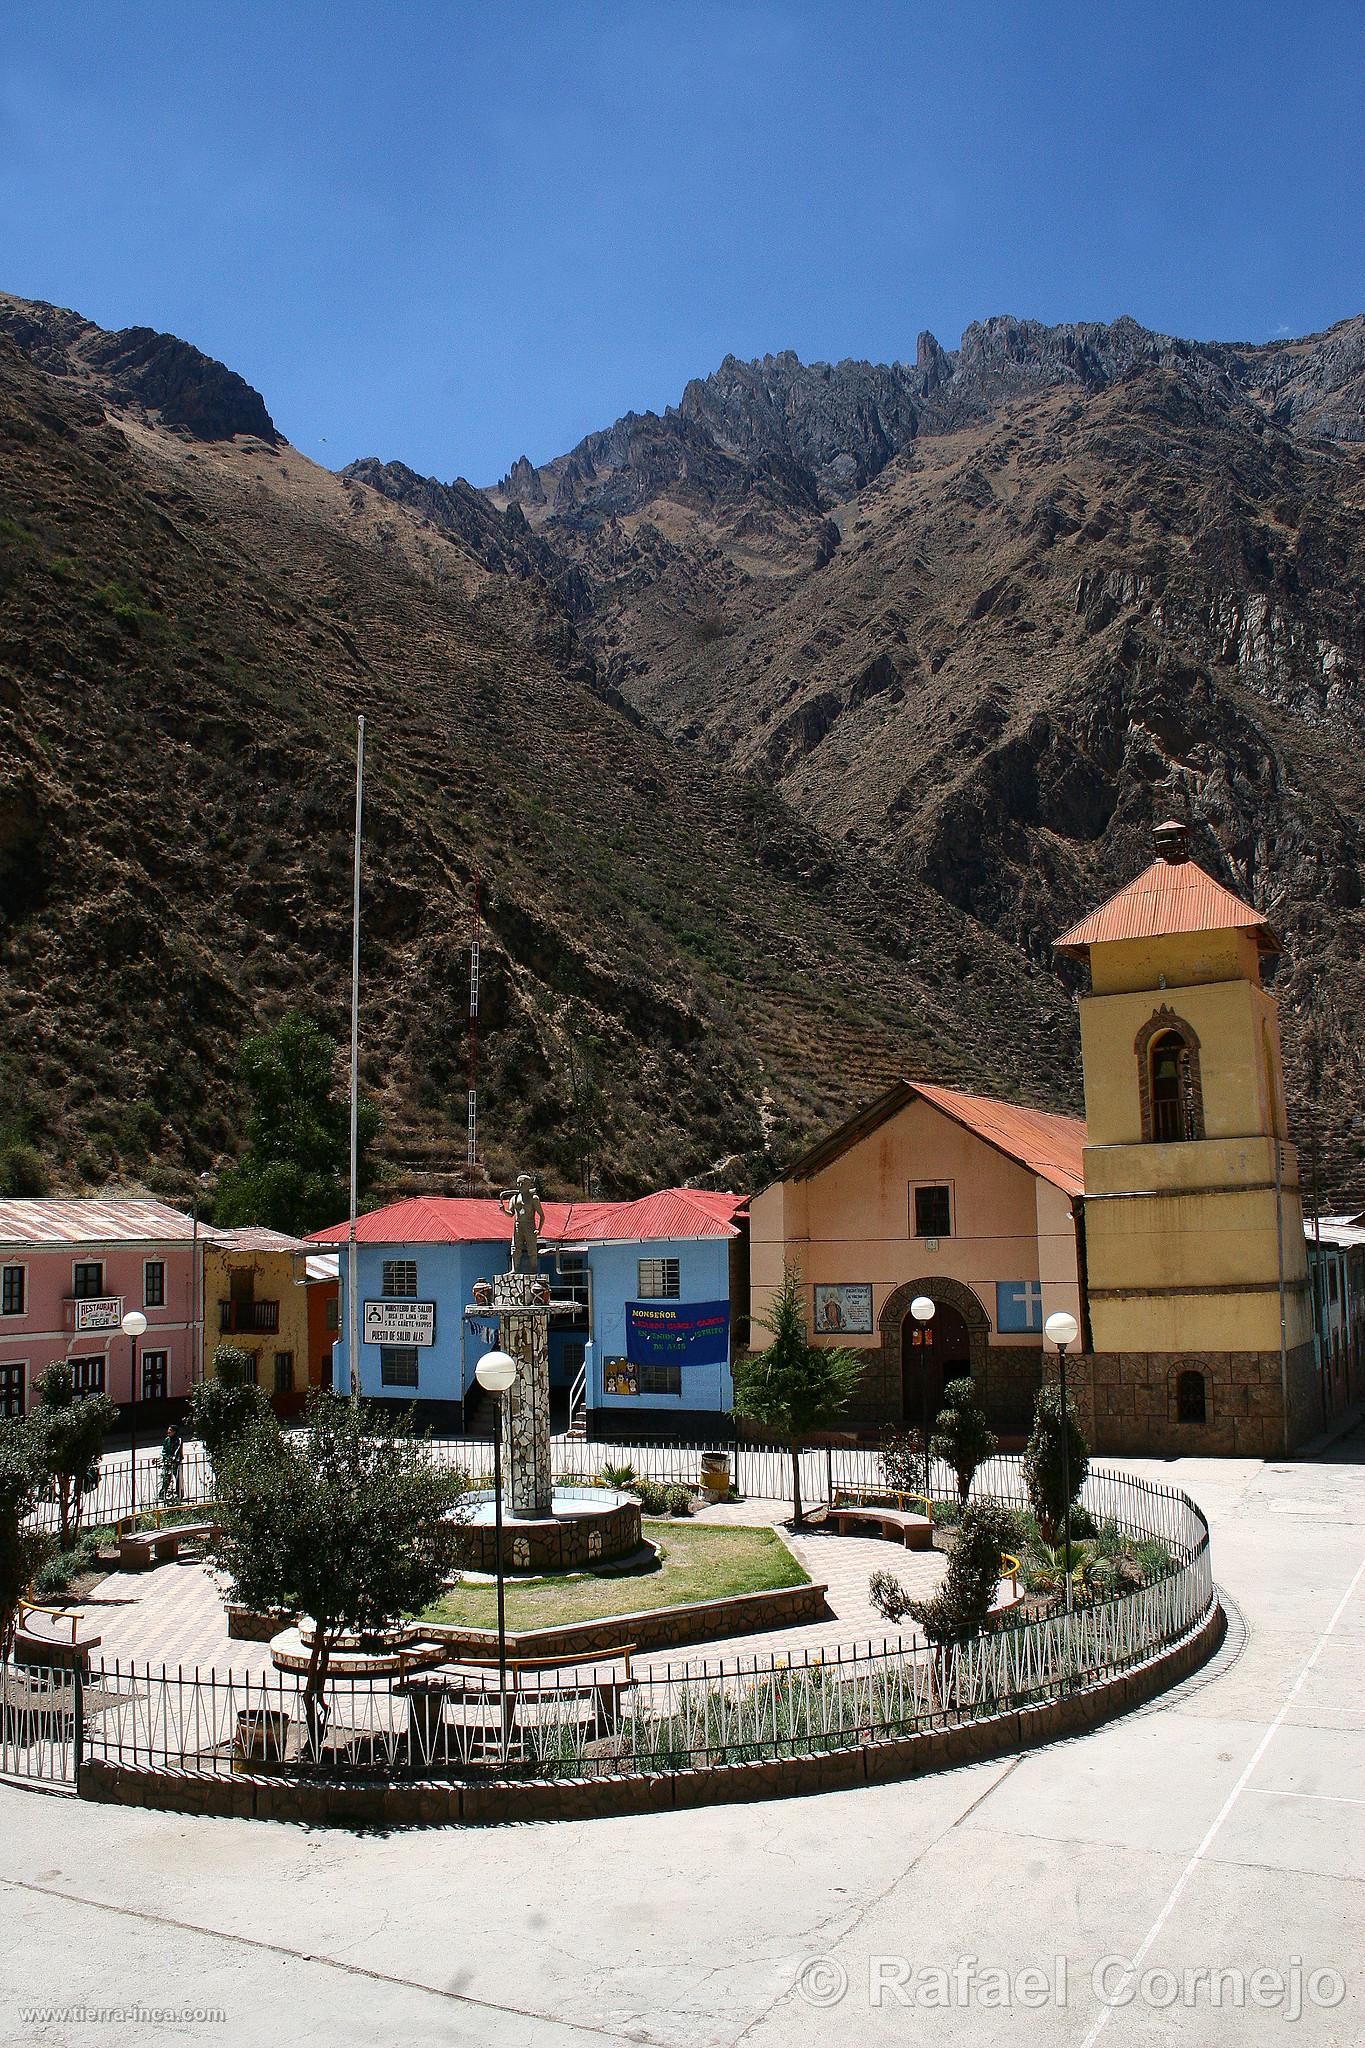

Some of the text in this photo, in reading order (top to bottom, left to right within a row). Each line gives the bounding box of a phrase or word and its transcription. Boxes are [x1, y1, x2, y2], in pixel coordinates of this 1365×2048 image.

[632, 1310, 676, 1318] MONSEÑOR
[372, 1331, 388, 1340] PUESTO
[390, 1331, 395, 1340] DE
